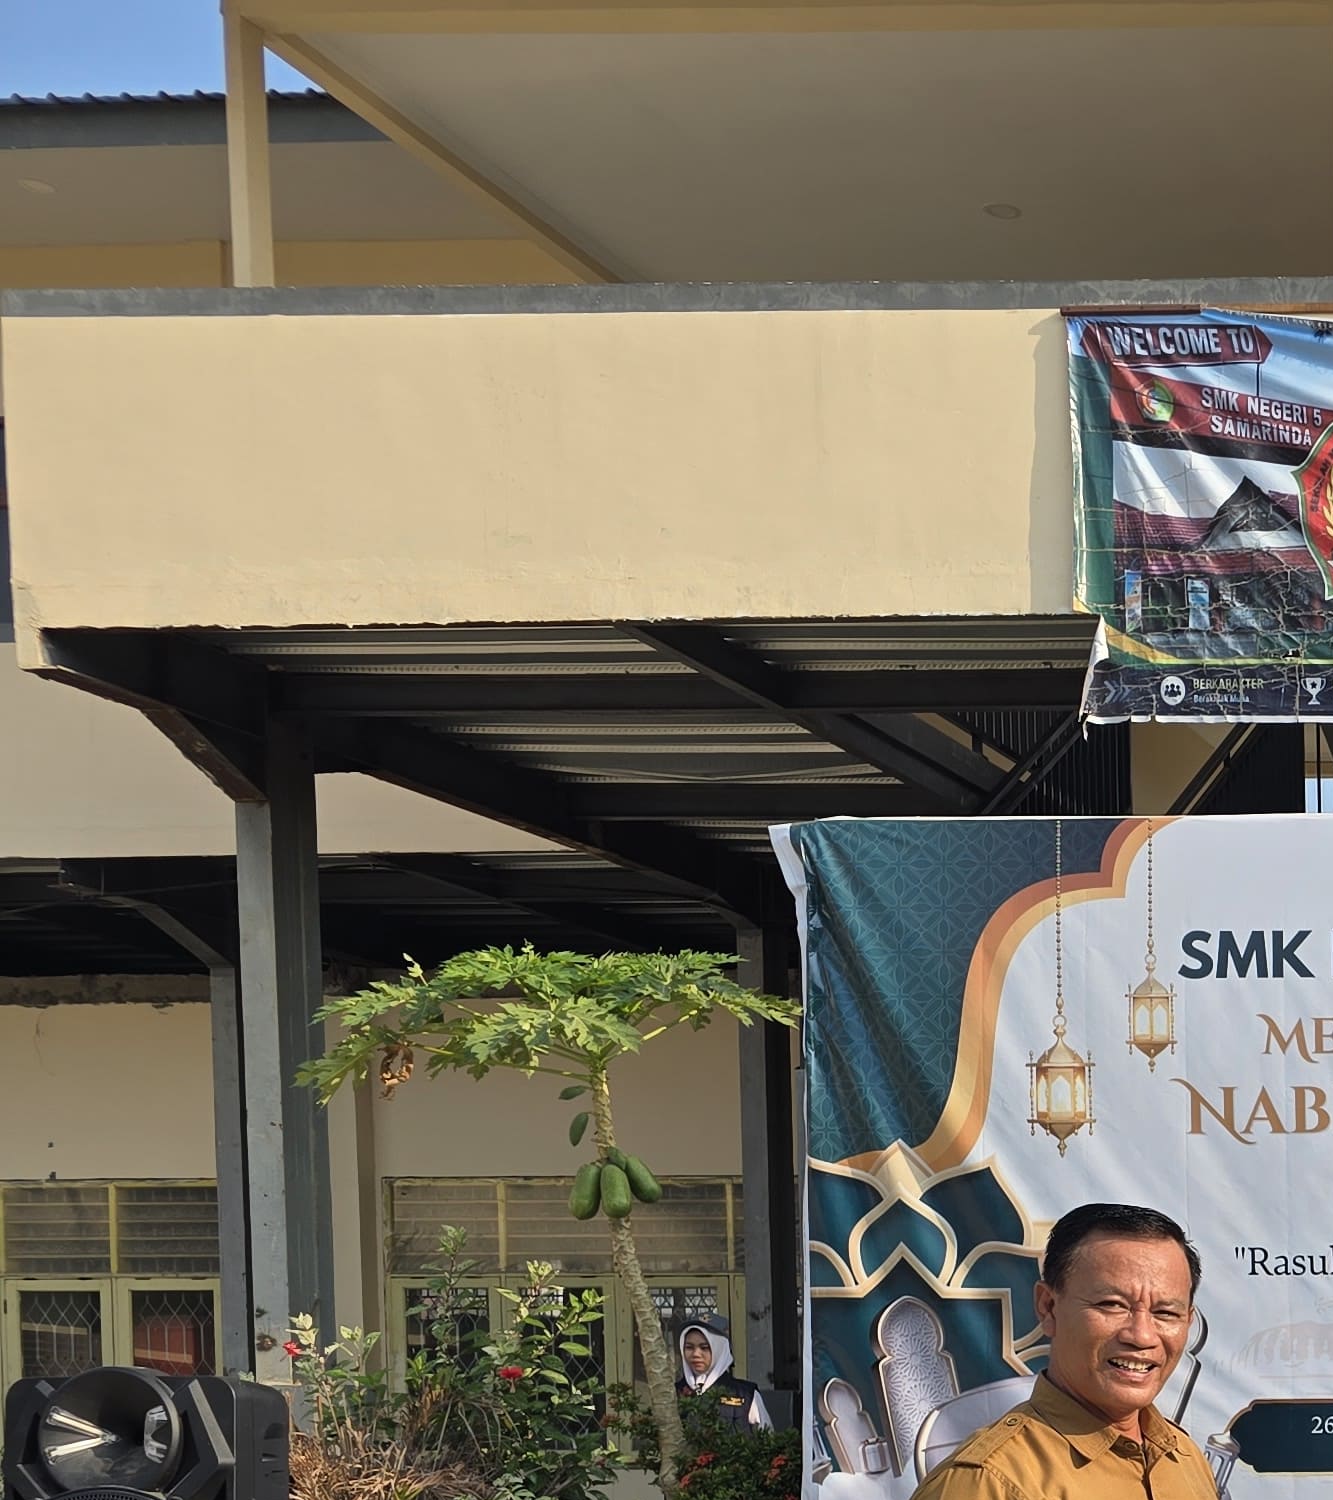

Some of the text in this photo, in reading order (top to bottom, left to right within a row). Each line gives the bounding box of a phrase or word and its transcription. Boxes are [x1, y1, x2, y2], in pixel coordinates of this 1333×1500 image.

[1106, 326, 1254, 356] WELCOME TO
[1200, 386, 1322, 428] SMK NEGERI 5
[1210, 414, 1313, 447] SAMARINDA
[1178, 929, 1316, 980] SMK
